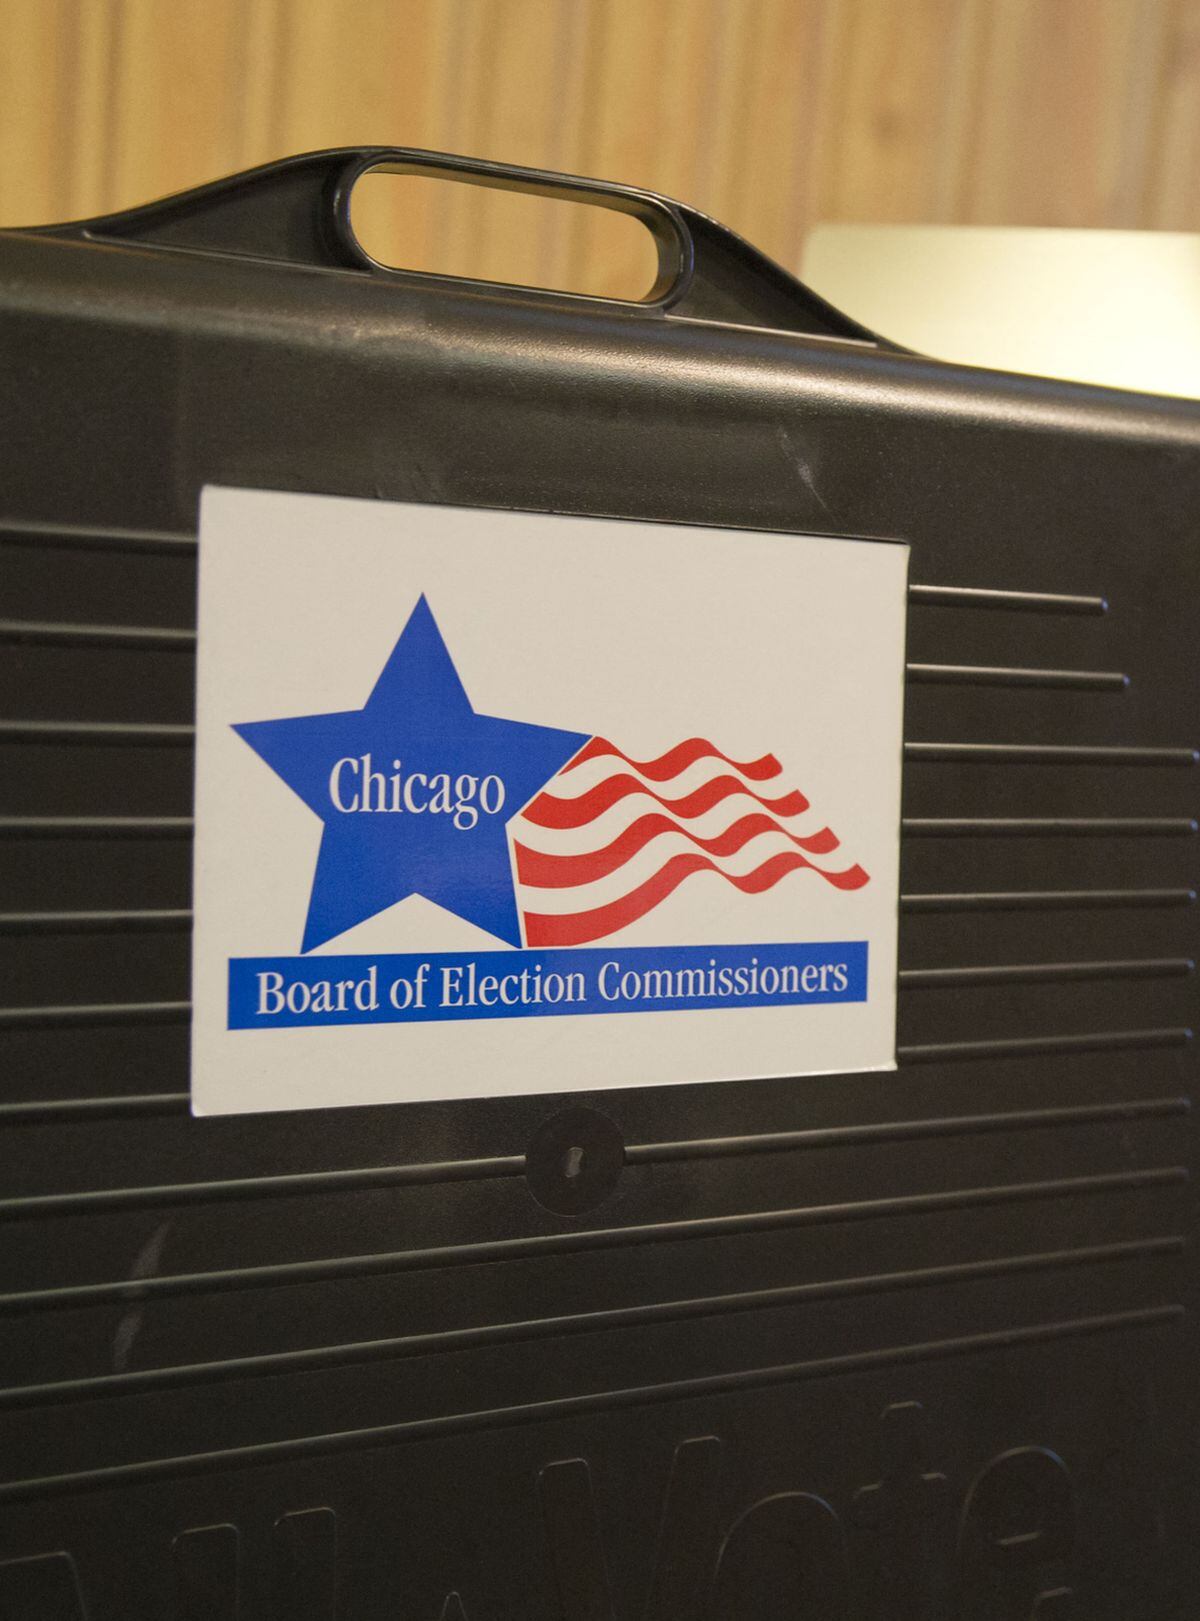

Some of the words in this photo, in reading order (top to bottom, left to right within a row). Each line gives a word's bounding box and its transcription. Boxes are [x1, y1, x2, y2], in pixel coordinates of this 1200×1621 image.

[329, 752, 506, 831] Chicago
[256, 966, 380, 1015] Board
[390, 963, 431, 1010] of
[439, 963, 587, 1007] Election
[597, 957, 849, 1002] Commissioners
